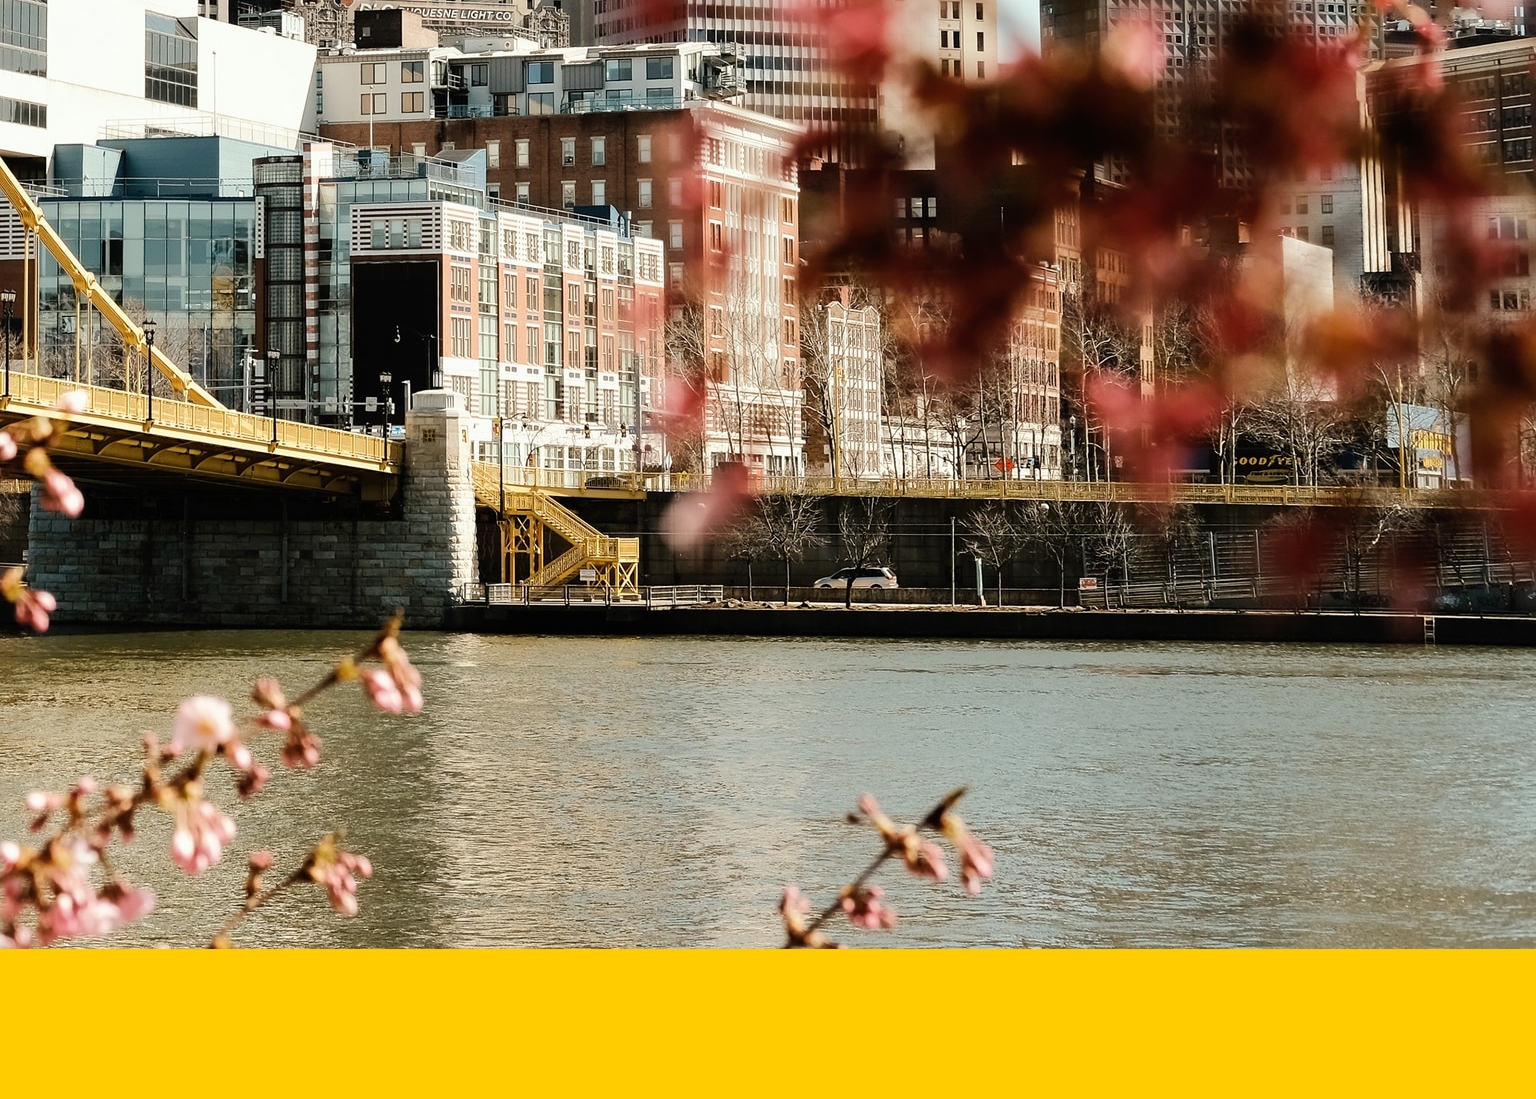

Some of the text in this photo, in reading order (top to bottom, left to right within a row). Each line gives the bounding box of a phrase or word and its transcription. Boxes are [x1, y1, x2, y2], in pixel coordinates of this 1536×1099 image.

[460, 10, 494, 20] LIGHT
[495, 11, 513, 21] CO.
[1233, 456, 1302, 466] OODYE
